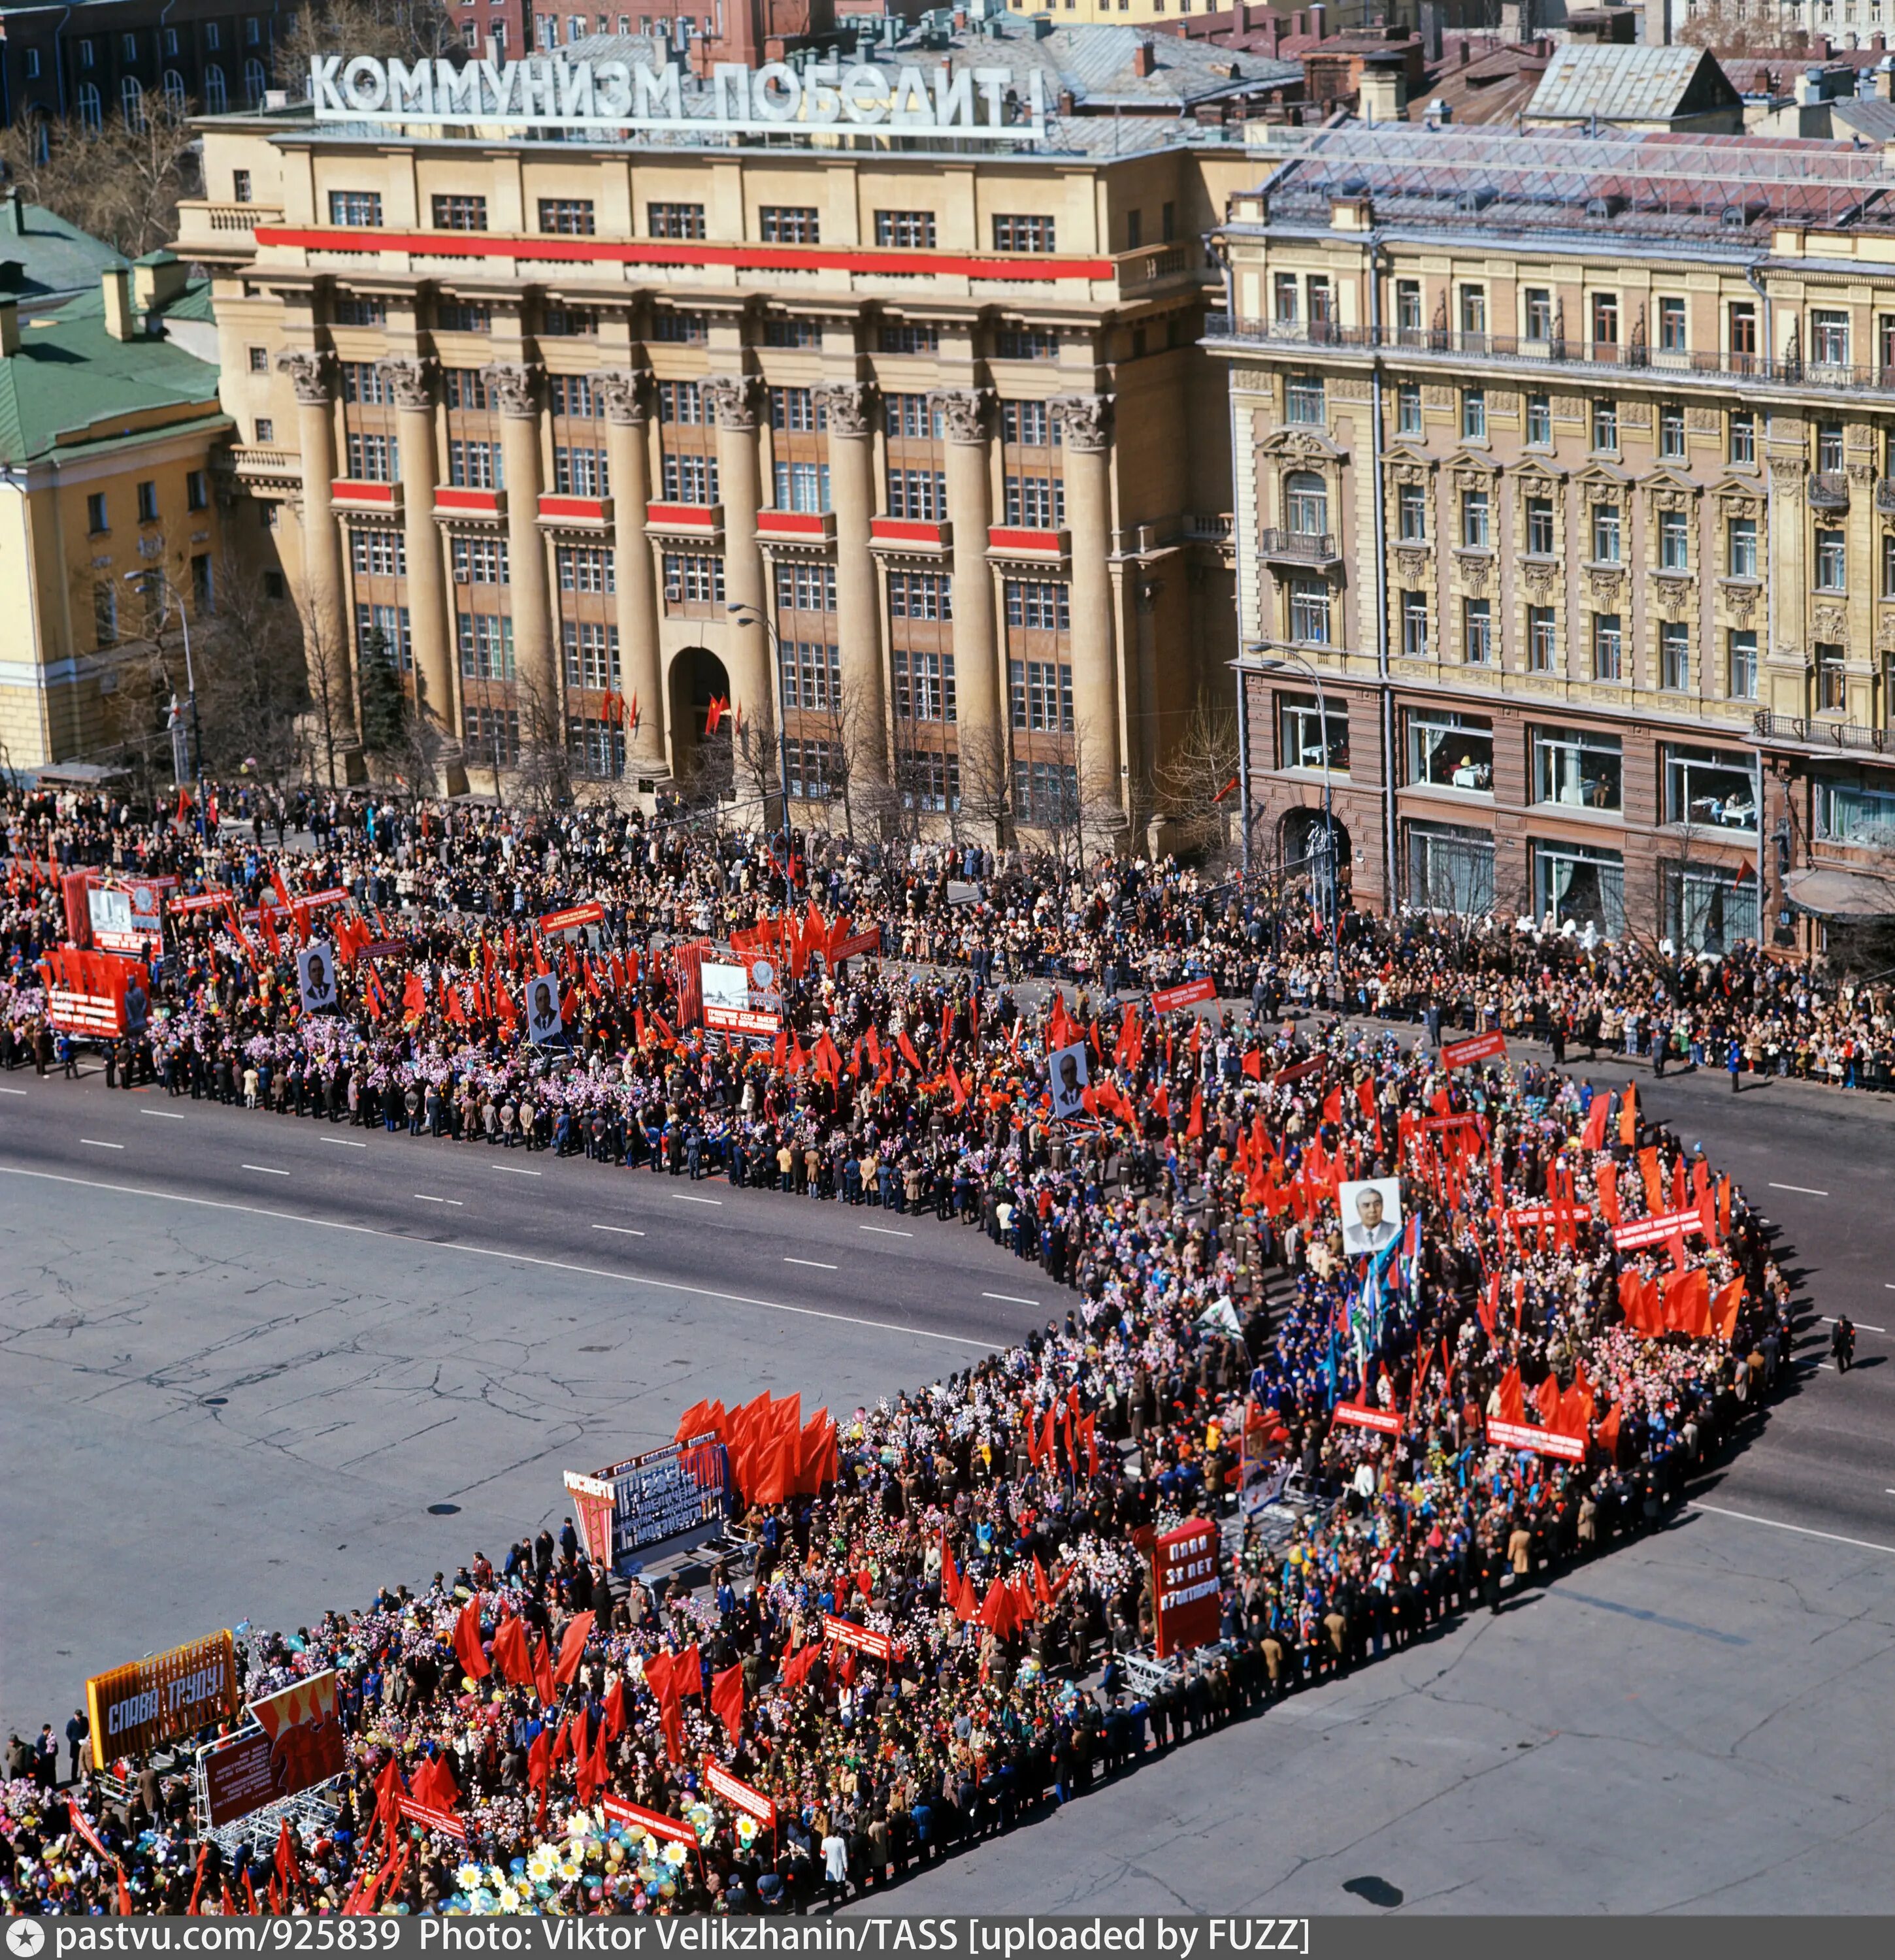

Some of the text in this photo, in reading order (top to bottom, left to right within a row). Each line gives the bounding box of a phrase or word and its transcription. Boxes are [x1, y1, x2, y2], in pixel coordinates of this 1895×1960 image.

[310, 54, 683, 119] КОММУНИЗМ
[1187, 1557, 1213, 1579] ЛЕТ
[108, 1663, 224, 1735] СЛАВА ТРУДУ!
